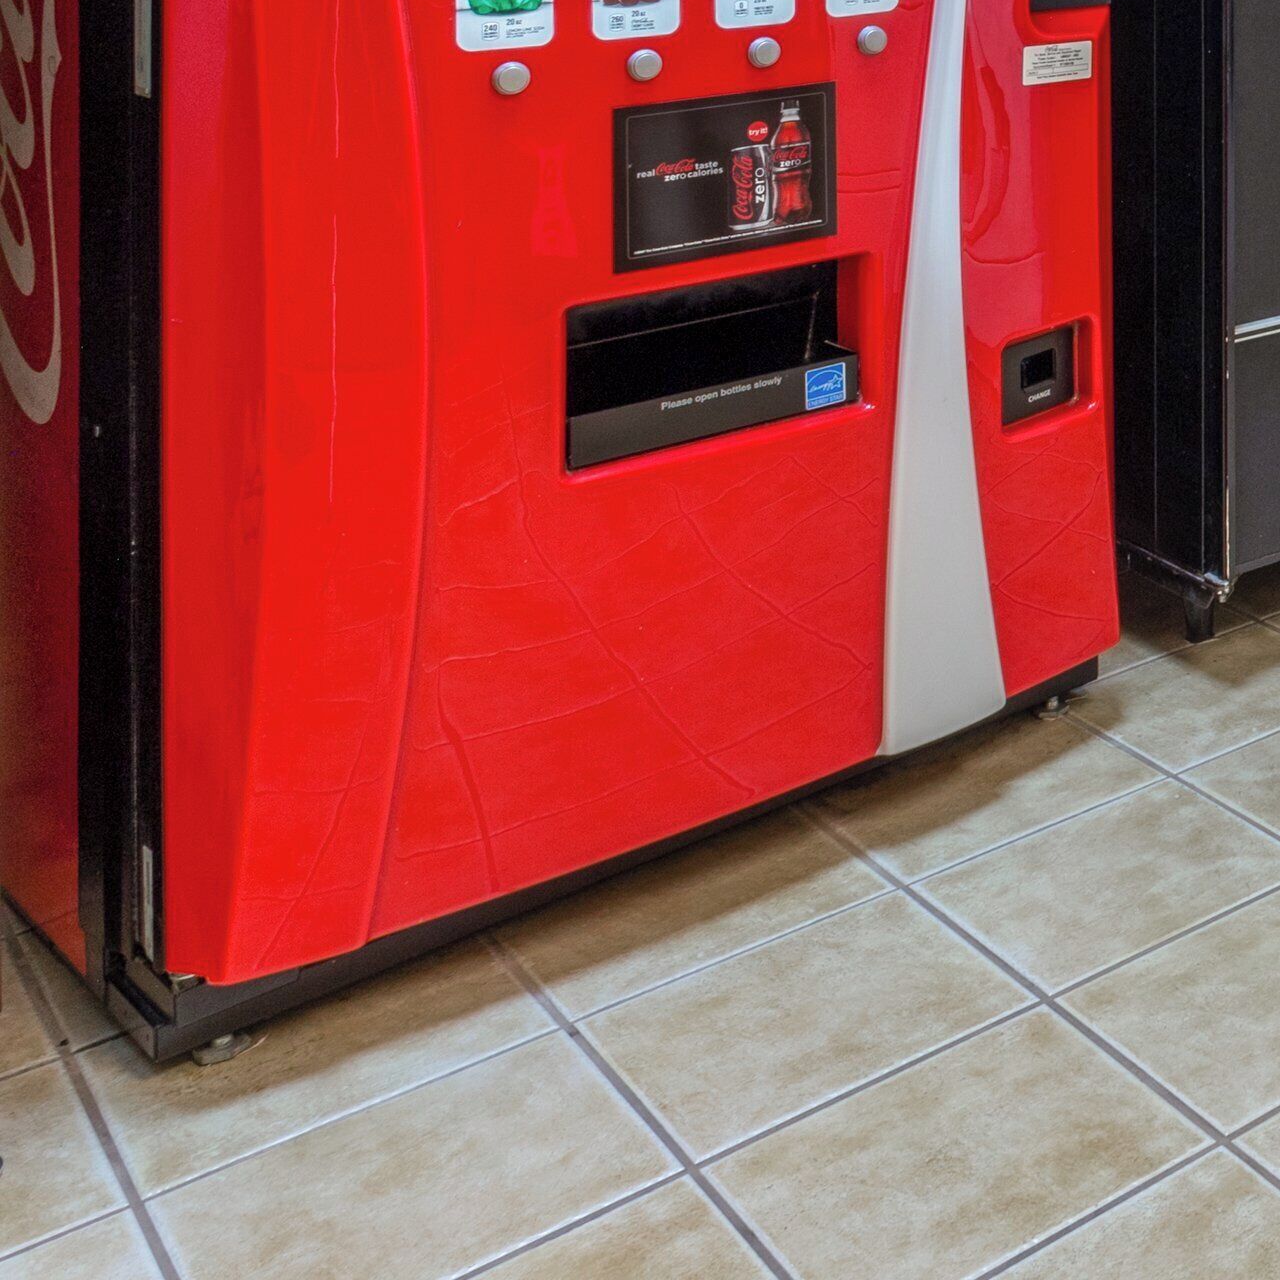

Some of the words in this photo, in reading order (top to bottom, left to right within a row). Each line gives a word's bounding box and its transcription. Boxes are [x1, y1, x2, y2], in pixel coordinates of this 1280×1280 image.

[483, 24, 498, 32] 240
[748, 128, 759, 136] try
[758, 126, 768, 134] it!
[636, 169, 656, 179] real
[655, 158, 696, 177] Coca-Cola
[695, 160, 719, 170] taste
[779, 158, 801, 168] zero
[663, 172, 687, 183] zero
[687, 167, 724, 178] calories
[731, 154, 753, 220] Coca-Cola
[755, 167, 765, 204] zero
[661, 397, 693, 411] Please
[695, 391, 719, 403] open
[720, 384, 752, 397] bottles
[753, 376, 783, 389] slowly
[1027, 388, 1051, 403] CHANGE
